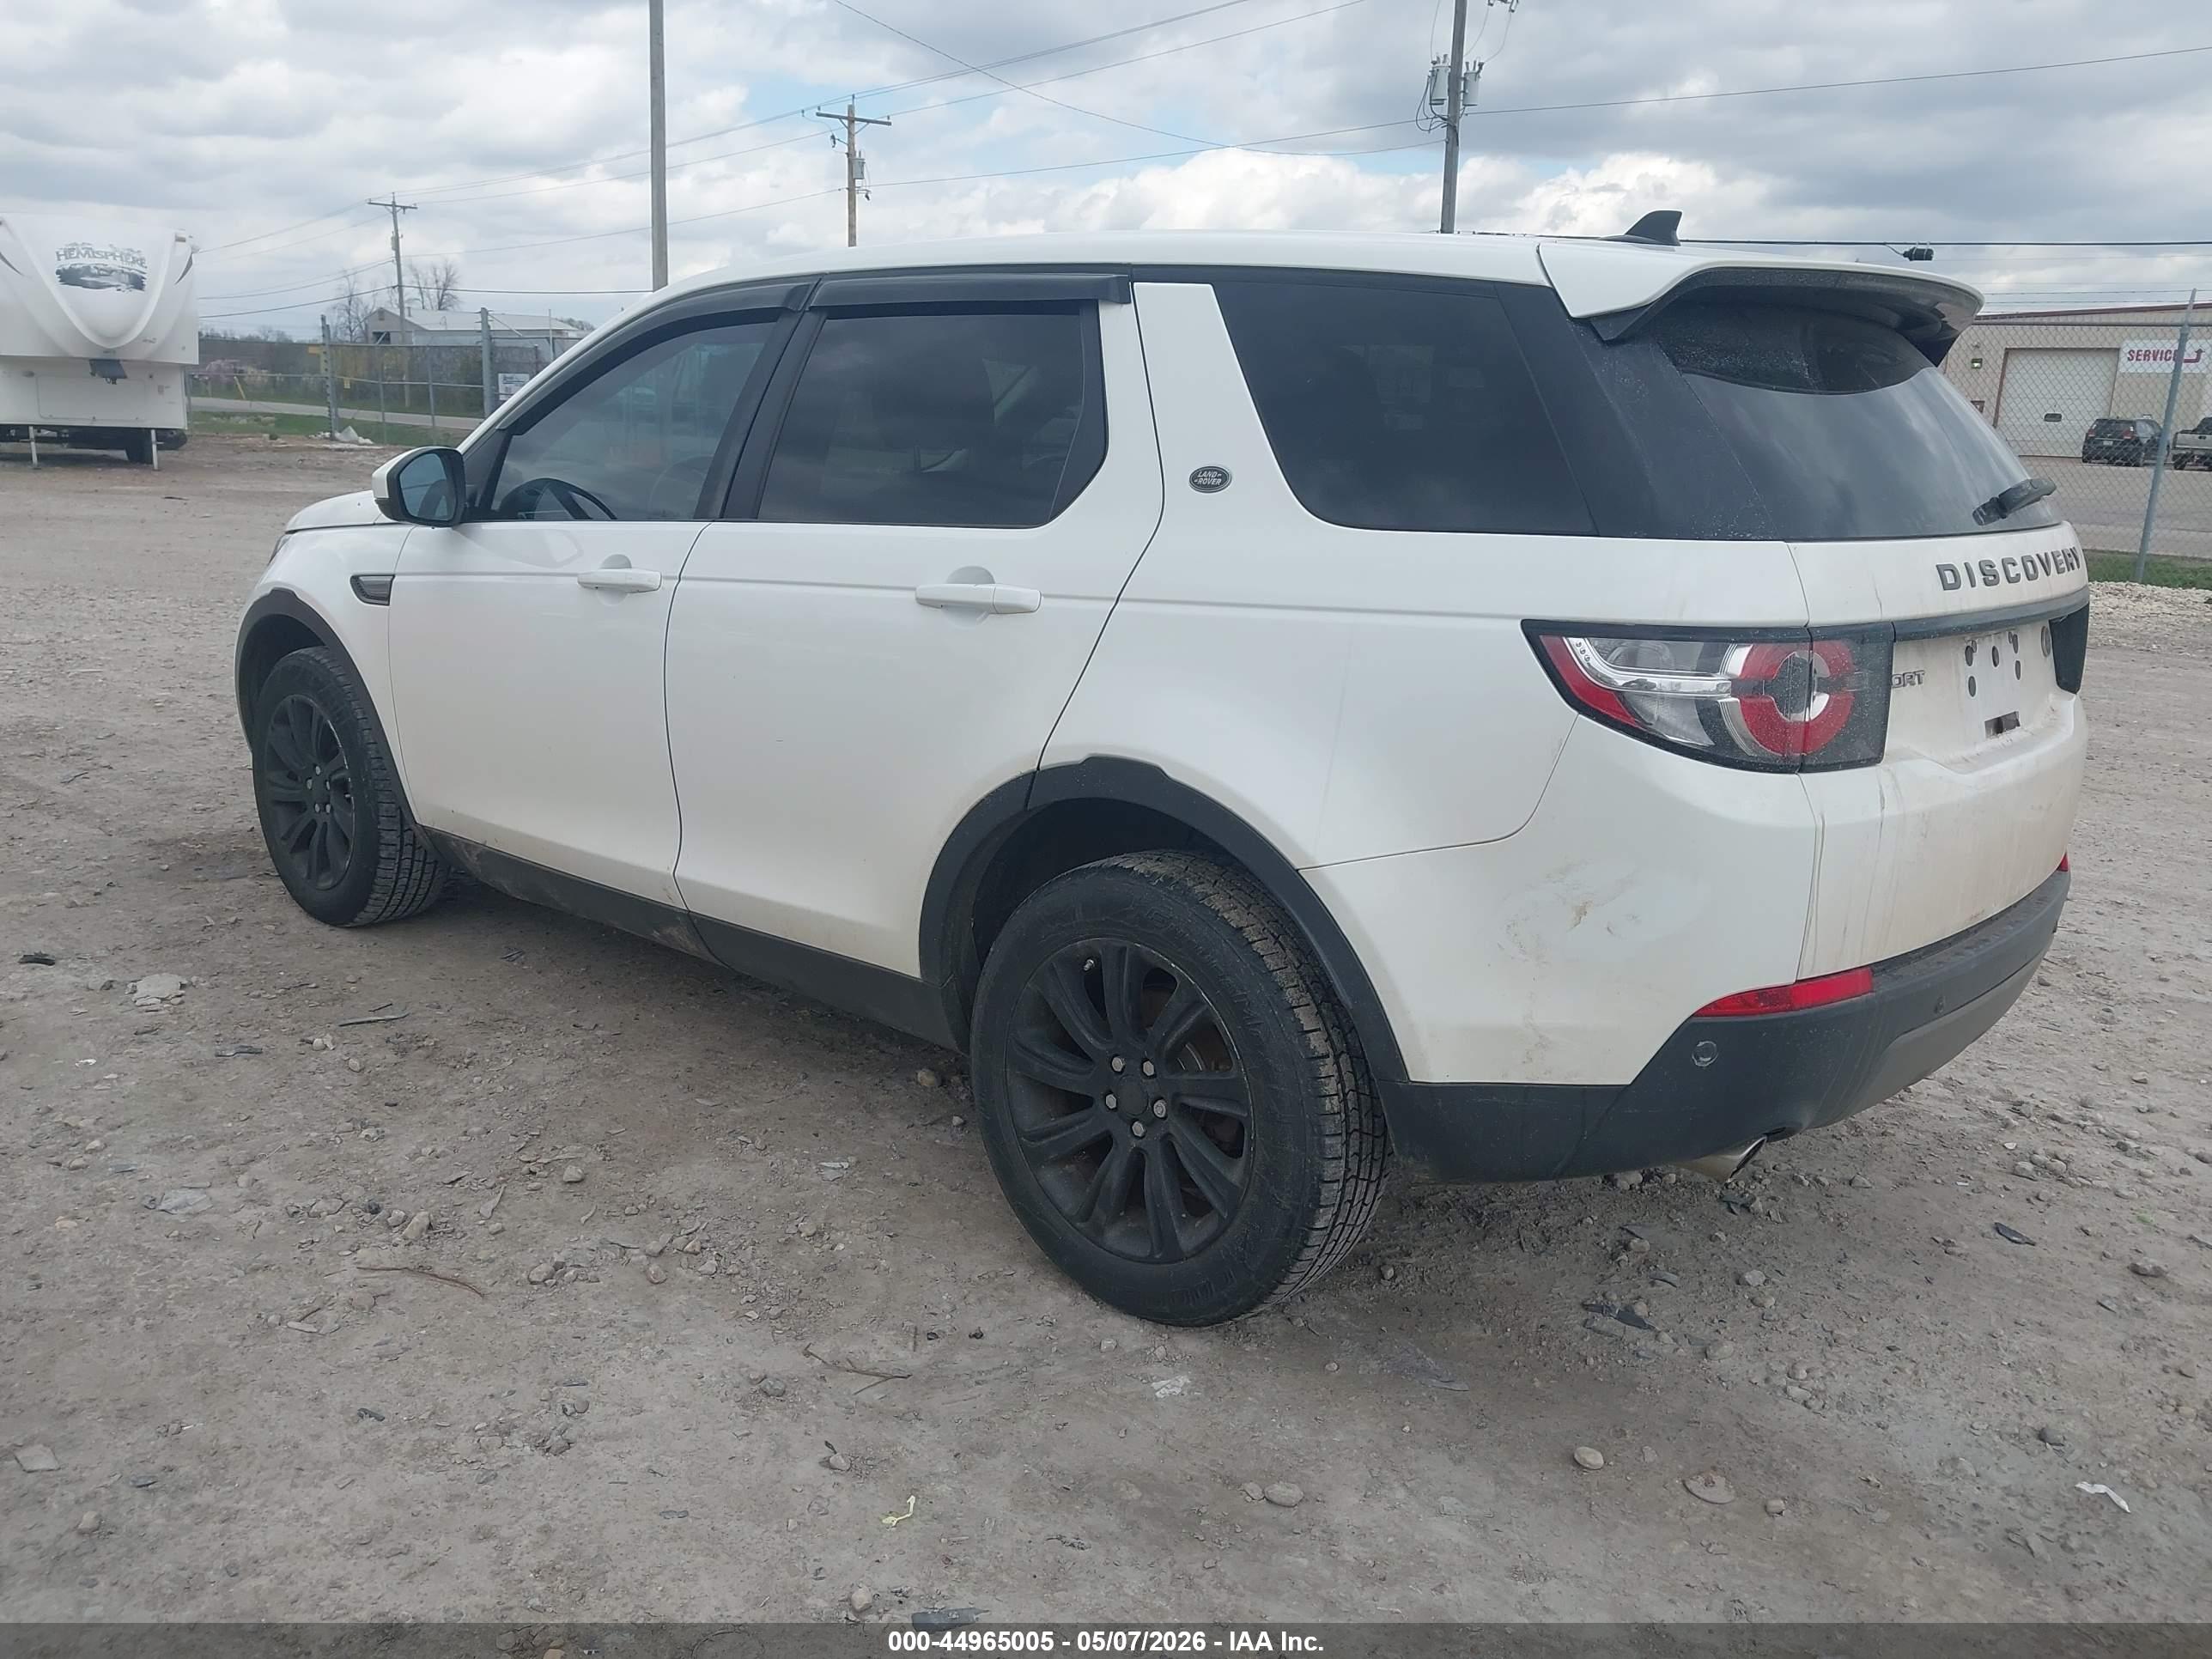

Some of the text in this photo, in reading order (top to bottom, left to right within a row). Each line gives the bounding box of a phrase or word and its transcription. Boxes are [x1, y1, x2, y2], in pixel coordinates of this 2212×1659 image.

[55, 248, 148, 269] HEMISPHERE
[1197, 477, 1222, 486] ROVER
[1936, 546, 2081, 591] DISCOVERY
[1891, 670, 1925, 689] ORT
